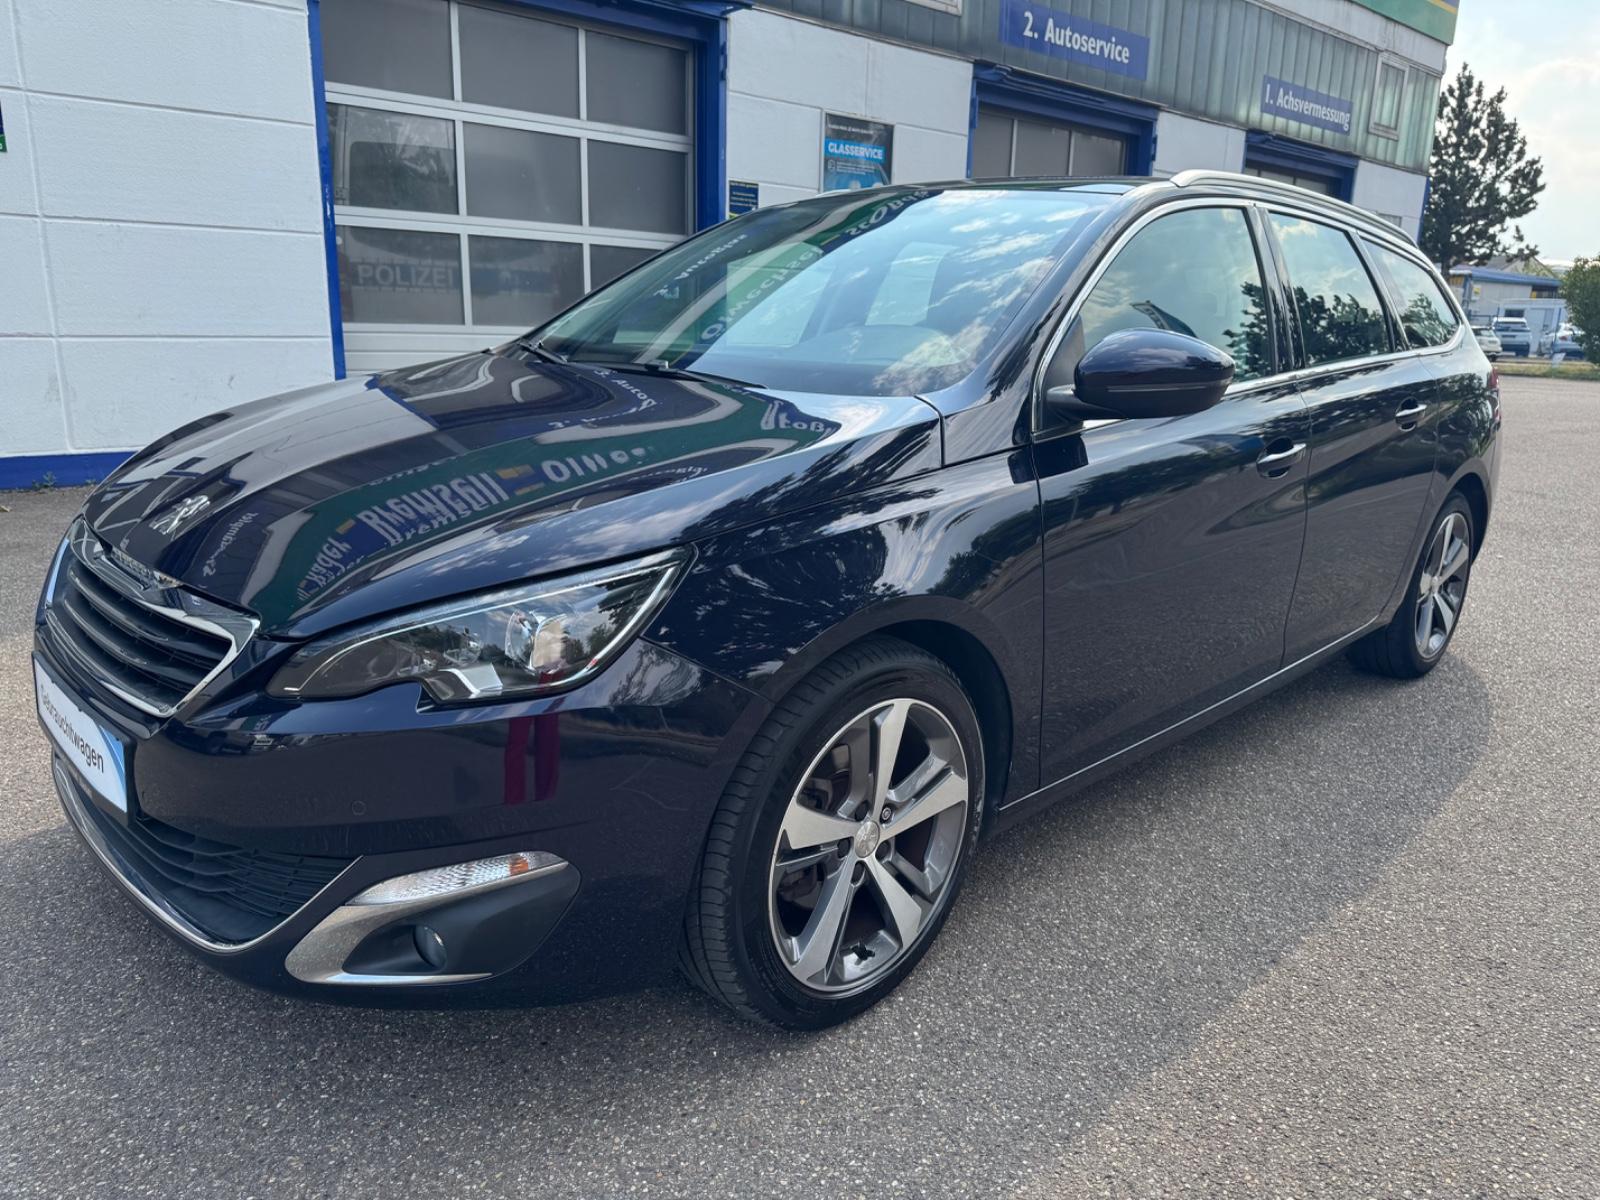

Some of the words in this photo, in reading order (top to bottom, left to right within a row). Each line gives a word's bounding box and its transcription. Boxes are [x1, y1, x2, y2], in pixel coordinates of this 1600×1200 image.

[1022, 10, 1039, 40] 2.
[1044, 17, 1130, 64] Autoservice
[1276, 87, 1351, 132] Achsvermessung
[827, 141, 884, 160] GLASSERVICE
[357, 263, 454, 288] POLIZEI
